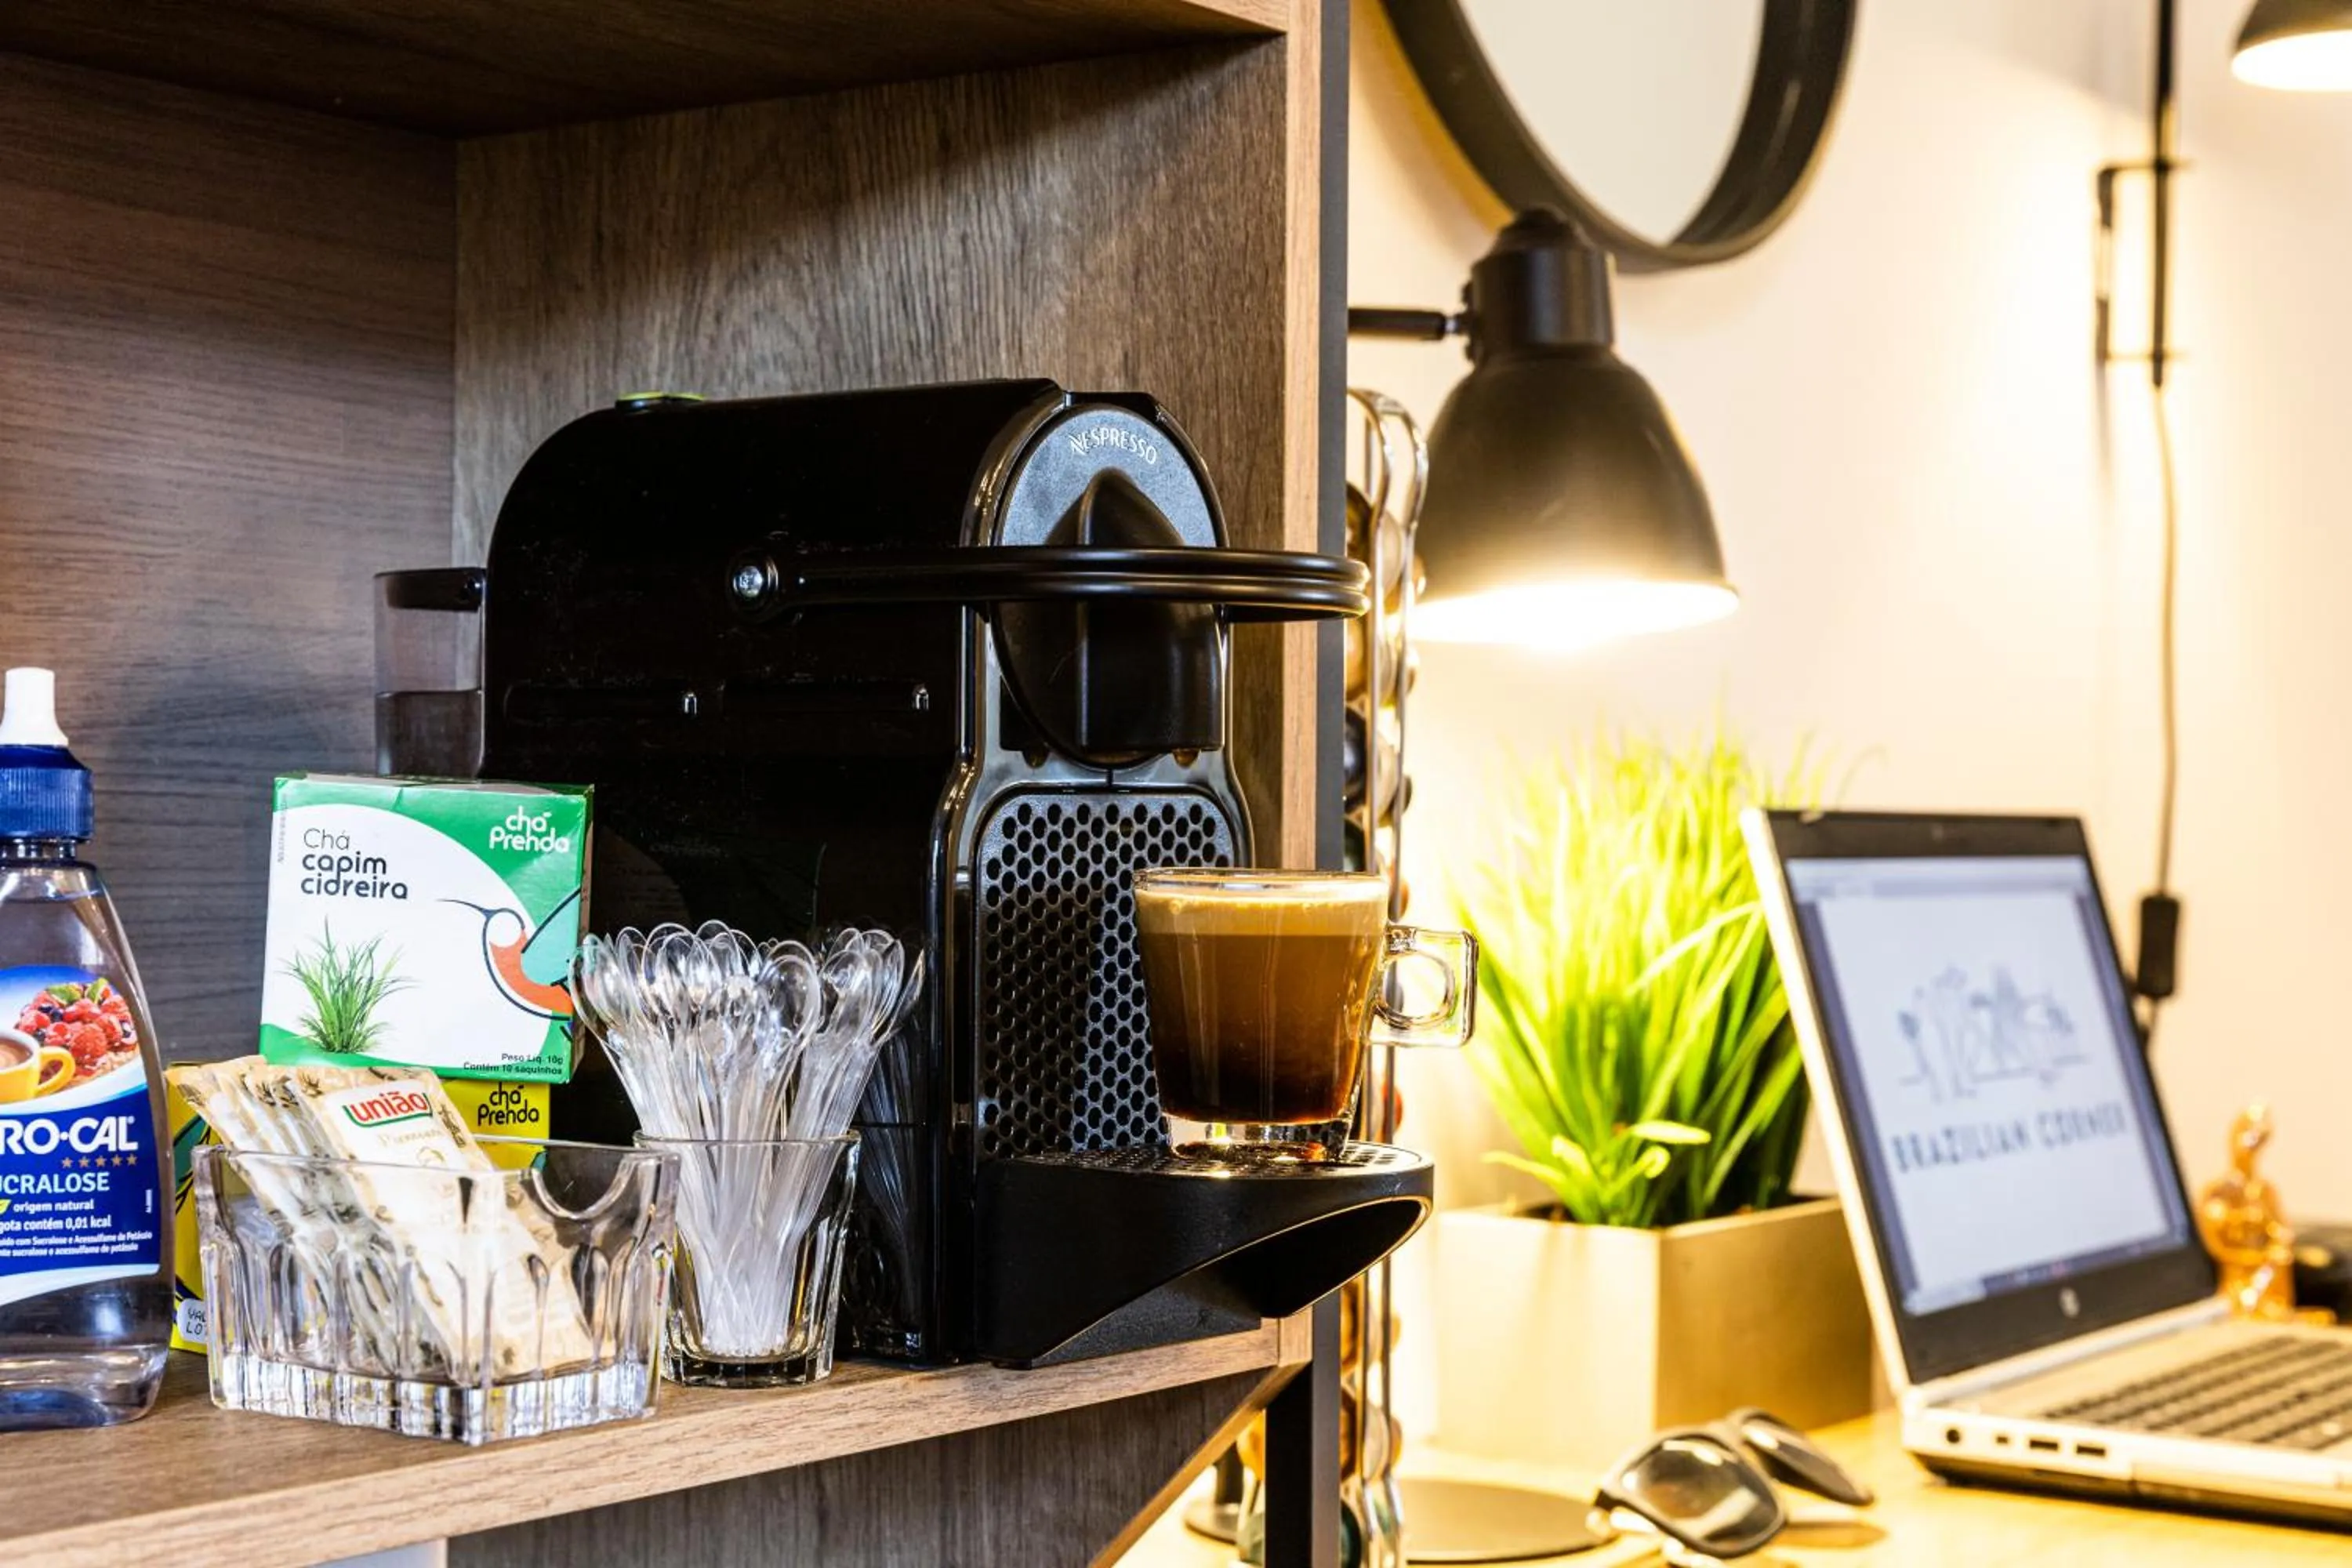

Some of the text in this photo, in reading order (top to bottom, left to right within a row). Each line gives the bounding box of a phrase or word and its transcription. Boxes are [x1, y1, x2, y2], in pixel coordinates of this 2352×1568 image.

[1069, 428, 1156, 464] NESPRESSO
[303, 828, 350, 851] Chá
[489, 826, 570, 854] Prenda
[302, 851, 387, 880] capim
[300, 873, 408, 899] cidreira
[463, 1062, 499, 1072] Contém
[514, 1065, 562, 1075] saquinhos
[502, 1053, 524, 1062] Peso
[547, 1055, 564, 1065] 10g
[350, 1091, 428, 1122] união
[477, 1099, 539, 1126] Prenda
[13, 1199, 95, 1214] origem natural
[24, 1217, 64, 1231] contém
[65, 1217, 88, 1231] 0,01
[90, 1214, 111, 1229] kcal
